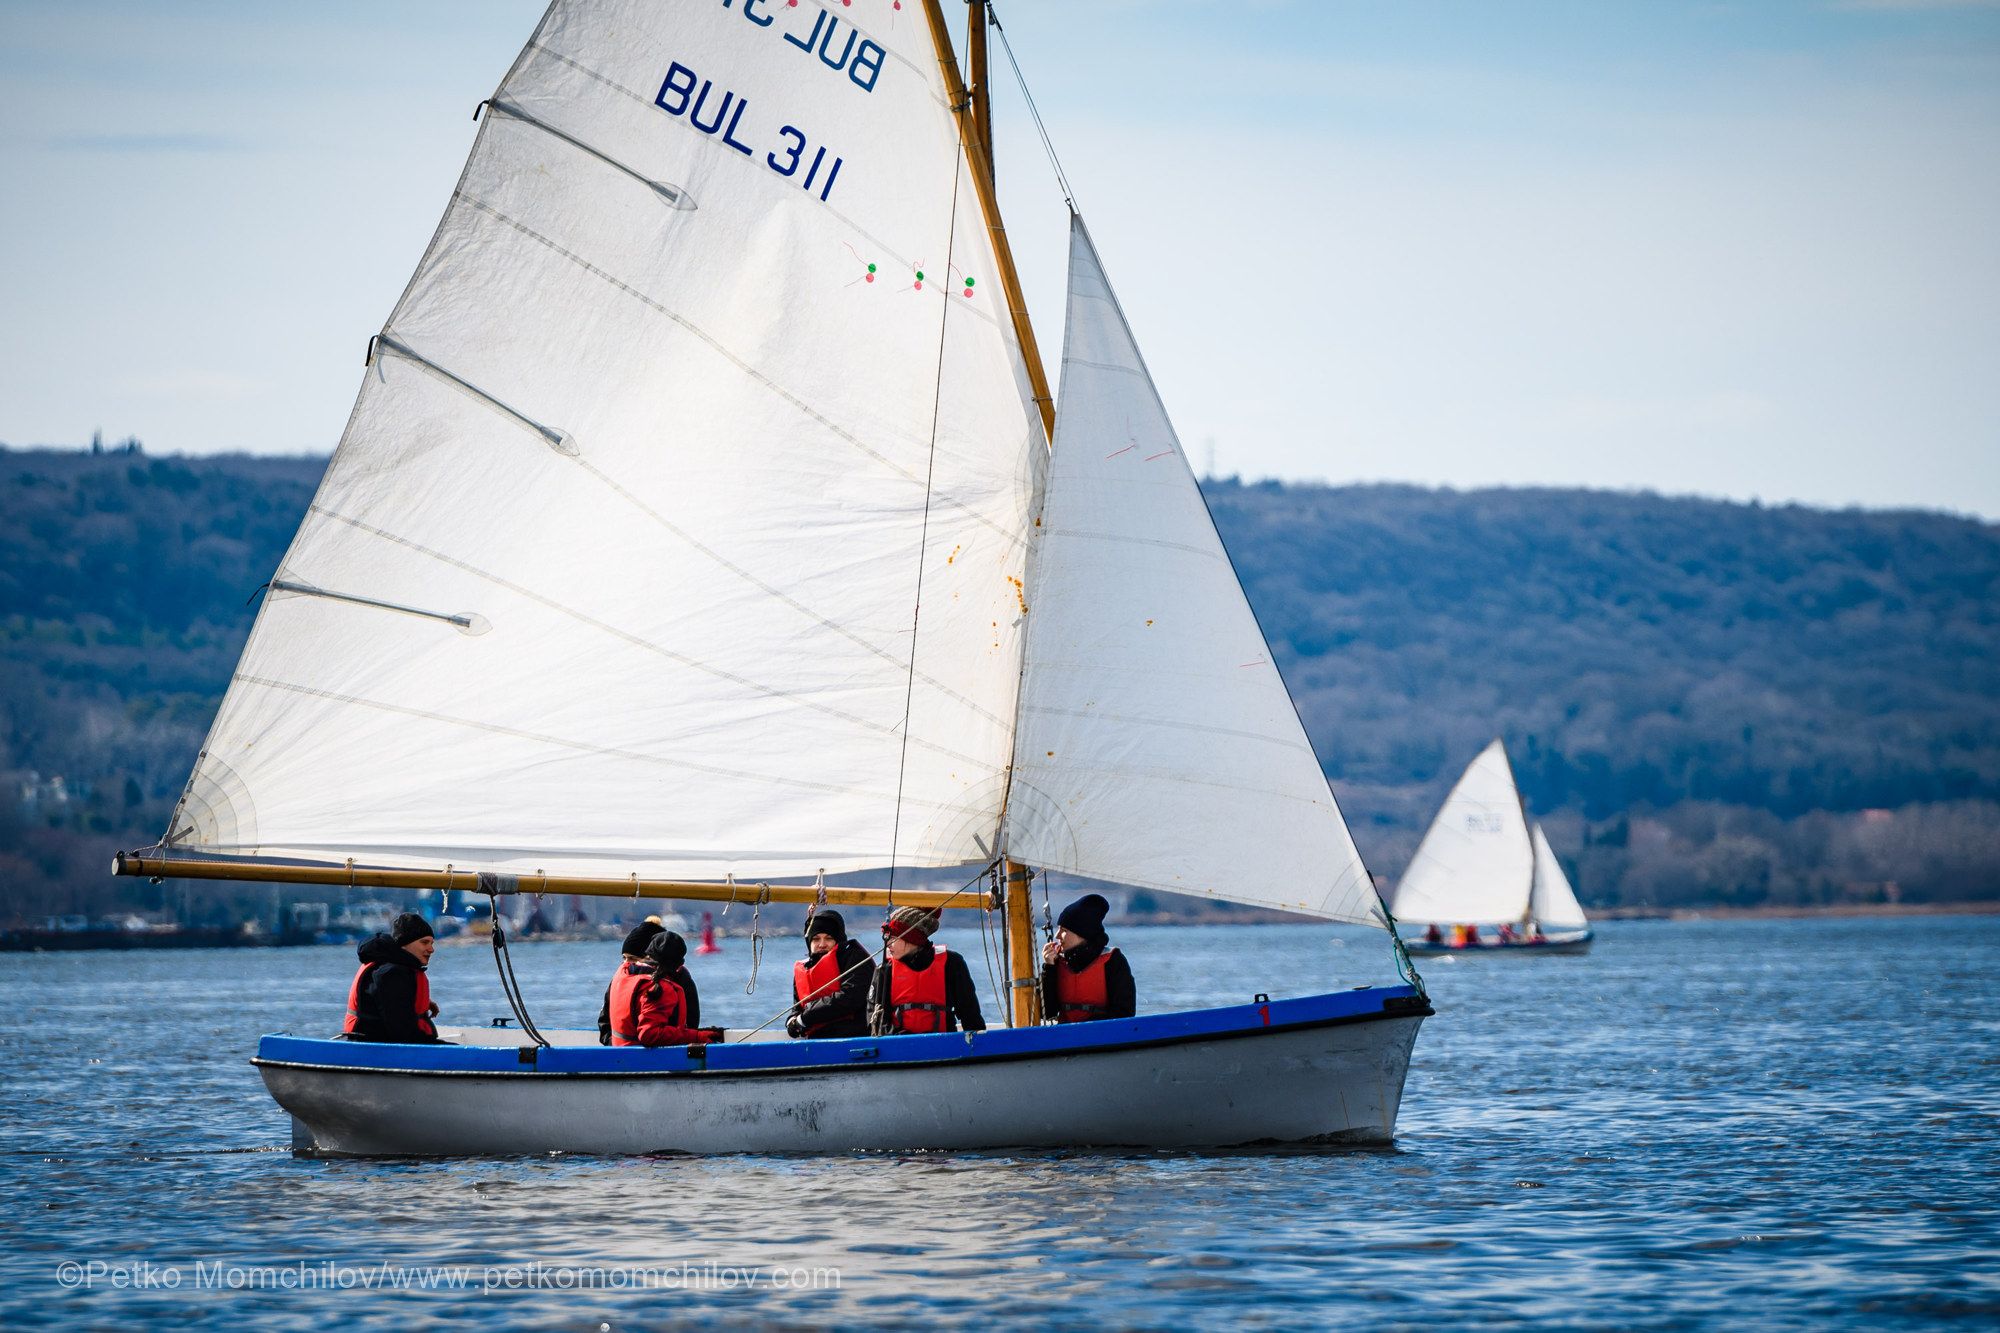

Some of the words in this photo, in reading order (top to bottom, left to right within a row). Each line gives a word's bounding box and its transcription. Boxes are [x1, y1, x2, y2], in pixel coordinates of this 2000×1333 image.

[654, 61, 753, 156] BUL
[767, 125, 843, 202] 311
[1258, 1005, 1271, 1027] 1
